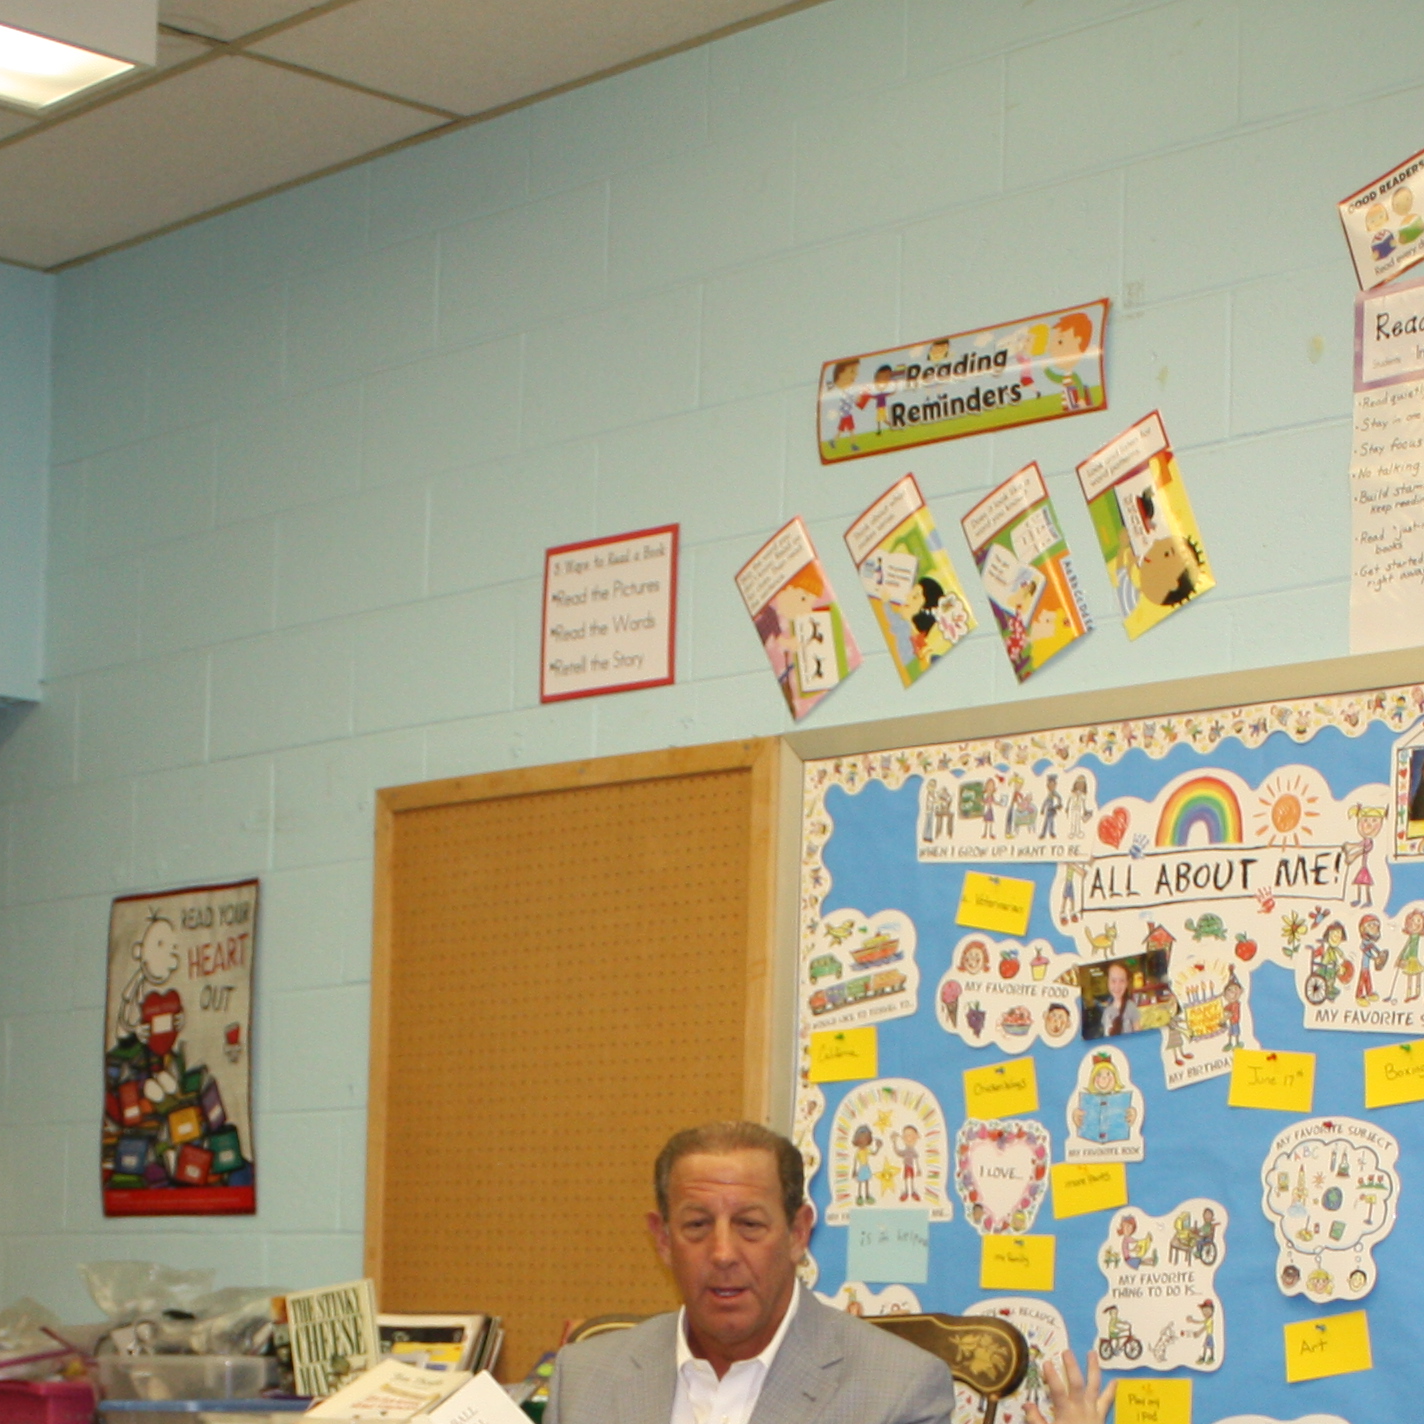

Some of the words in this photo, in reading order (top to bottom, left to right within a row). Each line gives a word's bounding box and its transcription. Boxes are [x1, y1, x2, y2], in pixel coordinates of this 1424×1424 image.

[1347, 187, 1378, 214] GOOD
[1374, 255, 1396, 275] Read
[1396, 247, 1417, 268] every
[906, 349, 1008, 386] Reading
[890, 382, 1022, 428] Reminders
[591, 585, 609, 600] the
[589, 620, 608, 635] the
[613, 611, 655, 633] Words
[590, 654, 608, 670] the
[613, 651, 644, 669] Story
[919, 845, 950, 859] WHEN
[956, 845, 988, 858] GROW
[990, 845, 1008, 858] UP
[1015, 844, 1047, 858] WANT
[1051, 844, 1065, 857] TO
[1090, 864, 1140, 900] ALL
[1155, 859, 1258, 896] ABOUT
[1275, 851, 1342, 887] ME!
[181, 907, 213, 930] READ
[218, 901, 250, 926] YOUR
[187, 933, 249, 979] HEART
[200, 984, 236, 1011] OUT
[965, 981, 983, 992] MY
[985, 982, 1038, 997] FAVORITE
[1040, 985, 1069, 998] FOOD
[1315, 1009, 1340, 1023] MY
[1343, 1010, 1415, 1026] FAVORITE
[1119, 1273, 1137, 1285] MY
[1140, 1271, 1195, 1284] FAVORITE
[316, 1287, 360, 1319] STINKY
[1112, 1287, 1144, 1299] THING
[1148, 1285, 1162, 1297] TO
[1166, 1285, 1182, 1297] DO
[295, 1315, 367, 1364] CHEESE
[1300, 1337, 1328, 1354] Art
